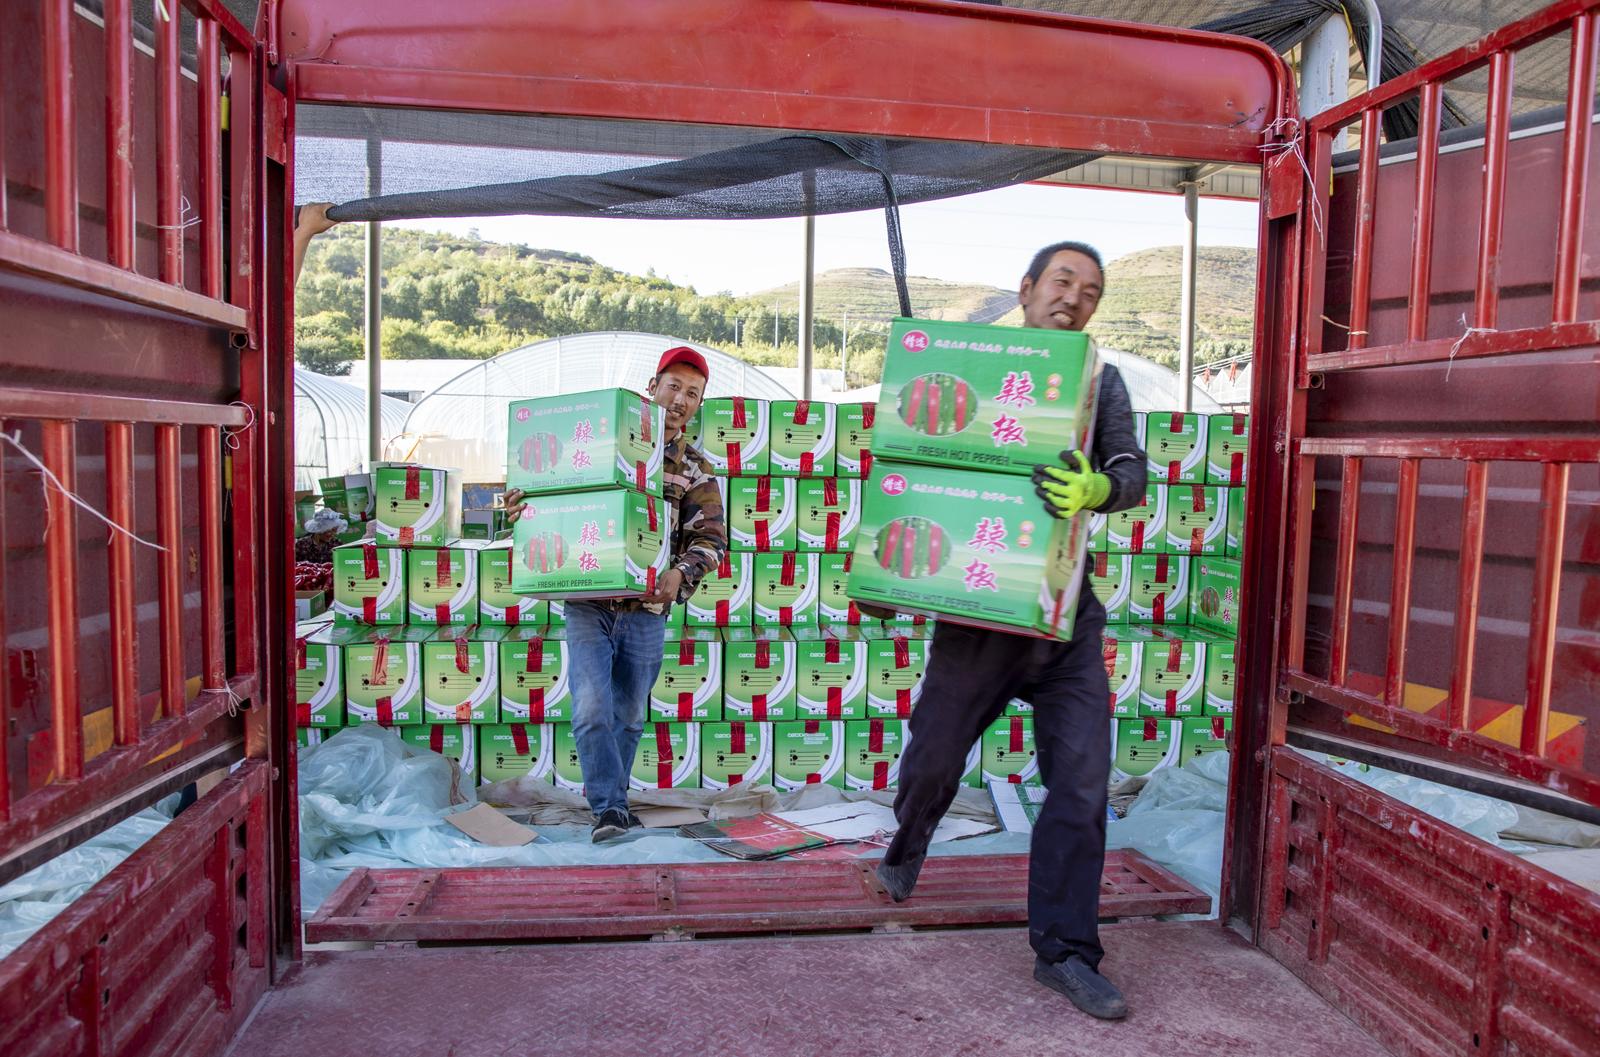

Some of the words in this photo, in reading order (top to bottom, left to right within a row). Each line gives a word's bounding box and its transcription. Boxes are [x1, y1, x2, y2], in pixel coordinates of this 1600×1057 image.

[992, 370, 1036, 447] 辣椒
[571, 419, 595, 474] 辣椒
[917, 445, 948, 458] FRESH
[950, 449, 970, 462] HOT
[972, 452, 1009, 466] PEPPER
[532, 478, 550, 487] FRESH
[551, 477, 562, 486] HOT
[563, 476, 585, 485] PEPPER
[577, 519, 601, 574] 辣椒
[964, 516, 1009, 592] 辣椒
[538, 580, 556, 589] FRESH
[557, 579, 569, 588] HOT
[570, 578, 593, 587] PEPPER
